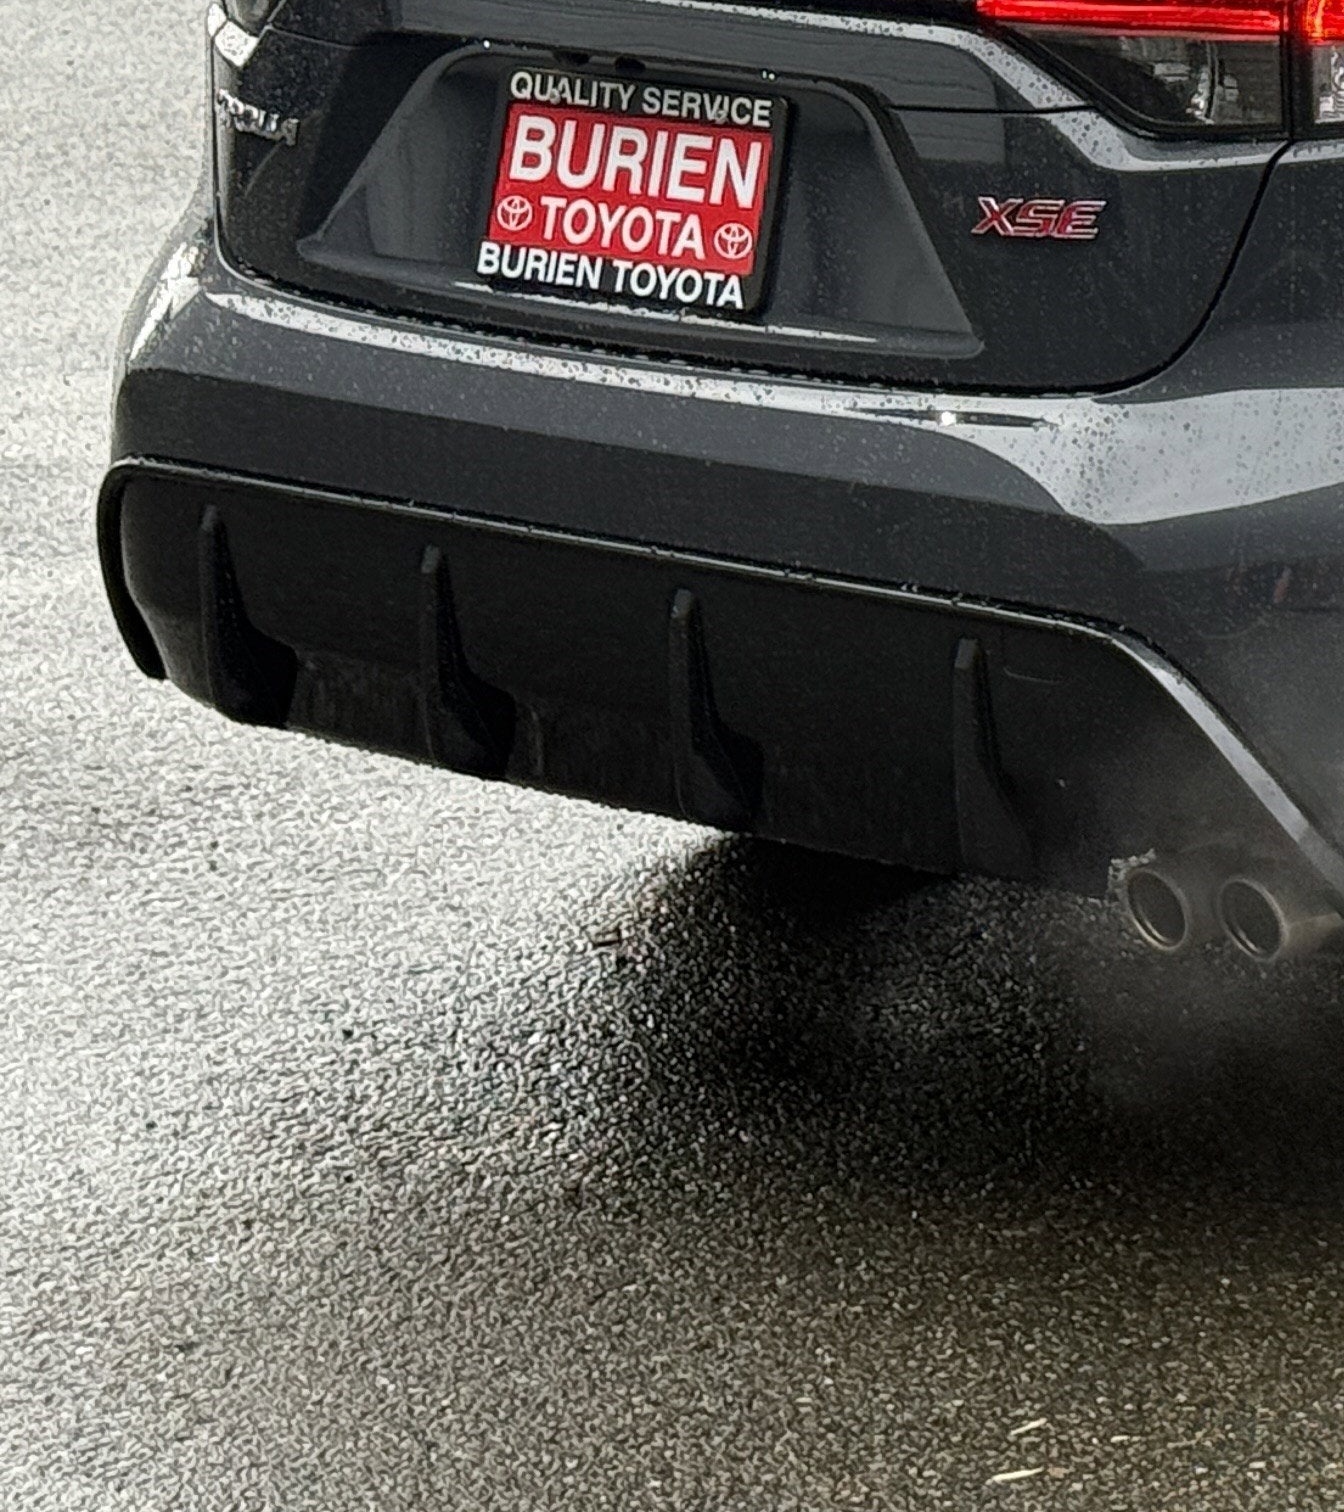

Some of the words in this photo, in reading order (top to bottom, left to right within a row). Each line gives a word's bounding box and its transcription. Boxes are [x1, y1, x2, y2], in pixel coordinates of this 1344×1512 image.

[510, 71, 635, 111] QUALITY
[642, 87, 772, 128] SERVICE
[509, 115, 762, 209] BURIEN
[540, 196, 705, 260] TOYOTA
[971, 196, 1107, 239] XSE
[477, 242, 602, 291] BURIEN
[612, 260, 744, 310] TOYOTA
